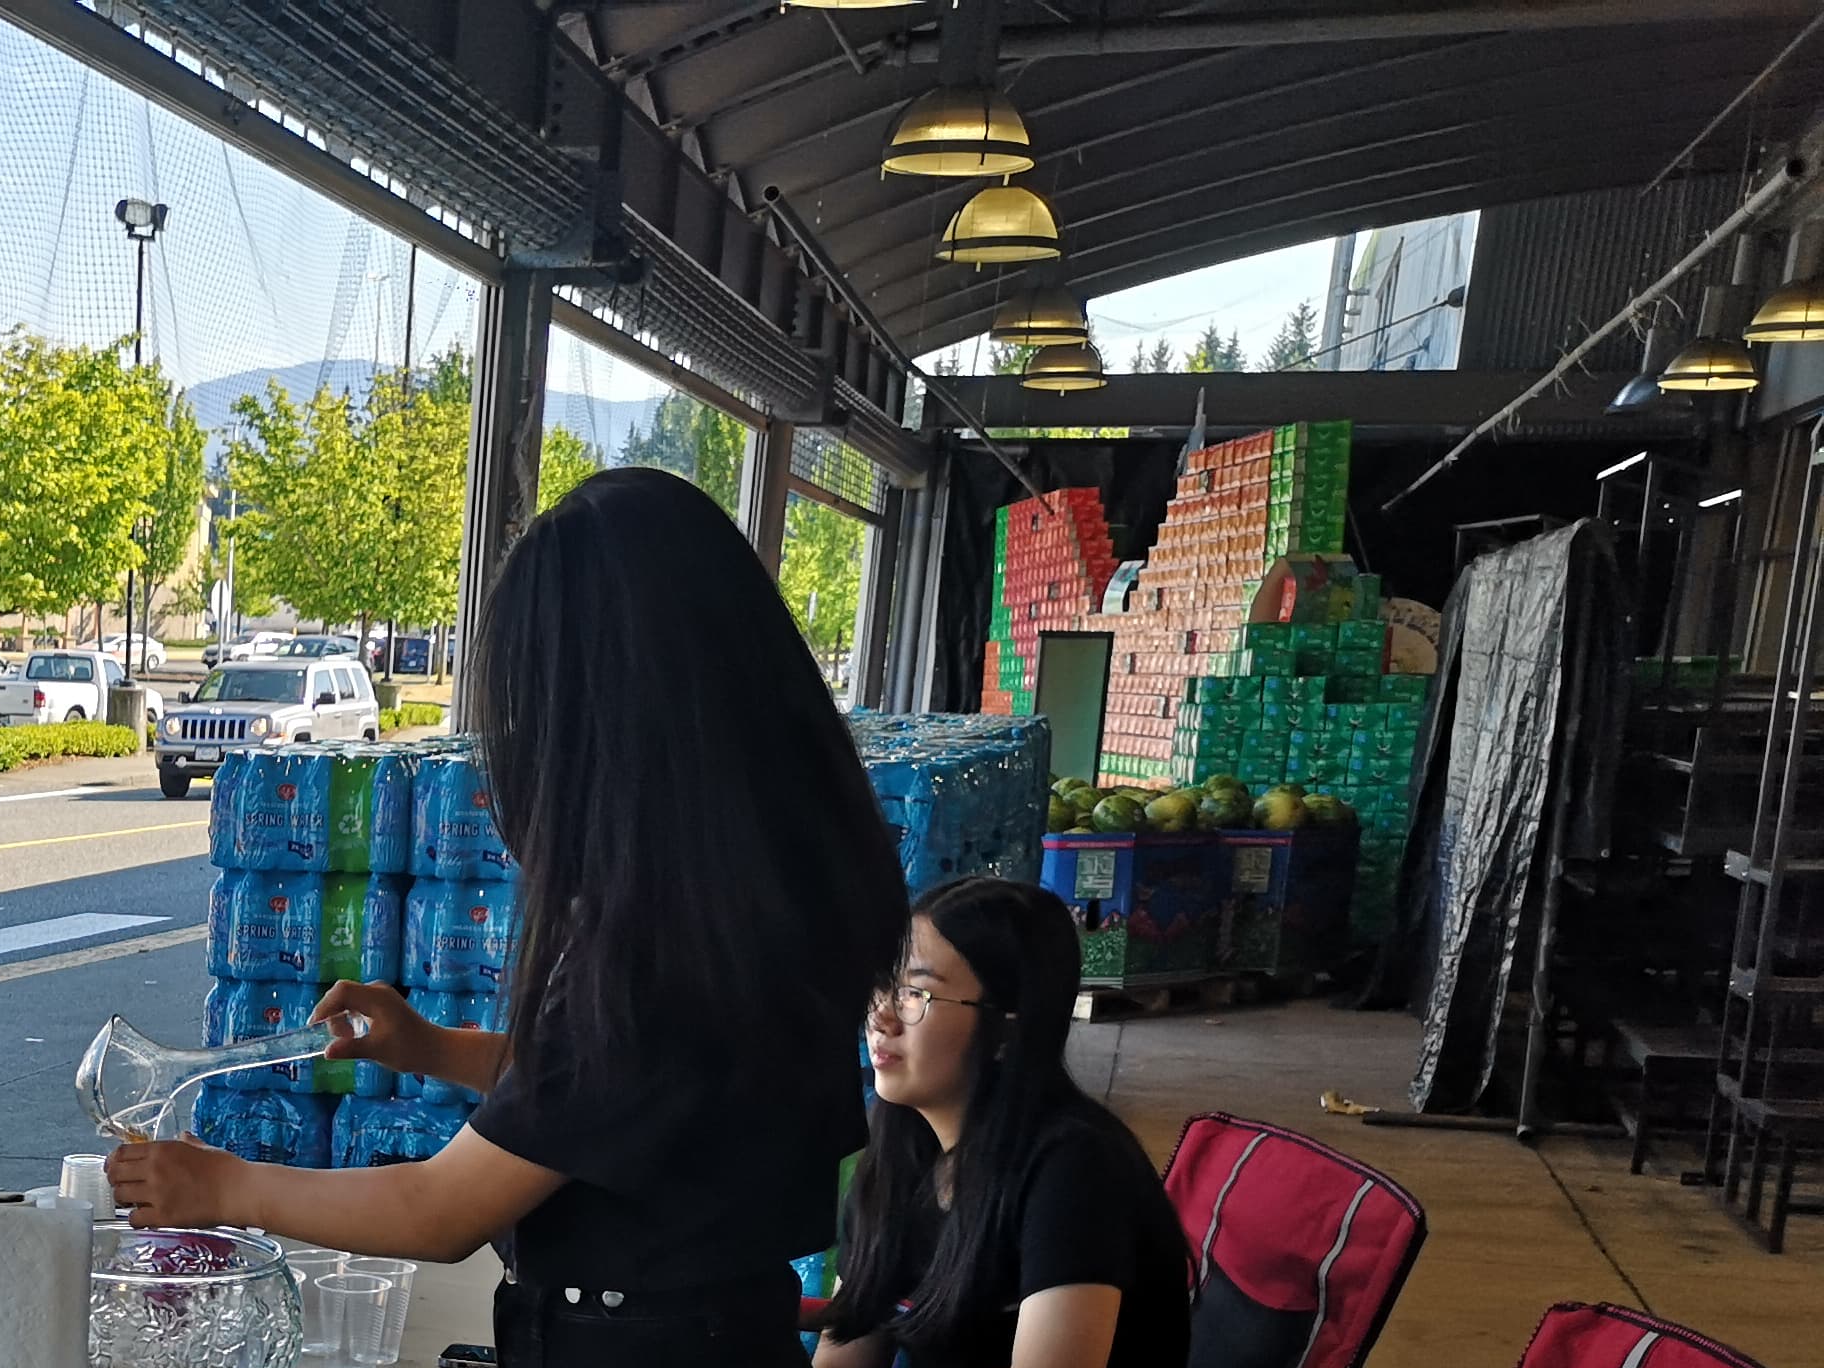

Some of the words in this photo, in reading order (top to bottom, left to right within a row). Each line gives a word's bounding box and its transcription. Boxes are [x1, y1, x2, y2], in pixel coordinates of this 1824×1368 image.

[245, 812, 283, 827] SPRING
[290, 813, 323, 827] WATER
[438, 822, 480, 838] SPRING
[237, 923, 275, 938] SPRING
[283, 925, 315, 939] WATER
[435, 934, 475, 949] SPRING
